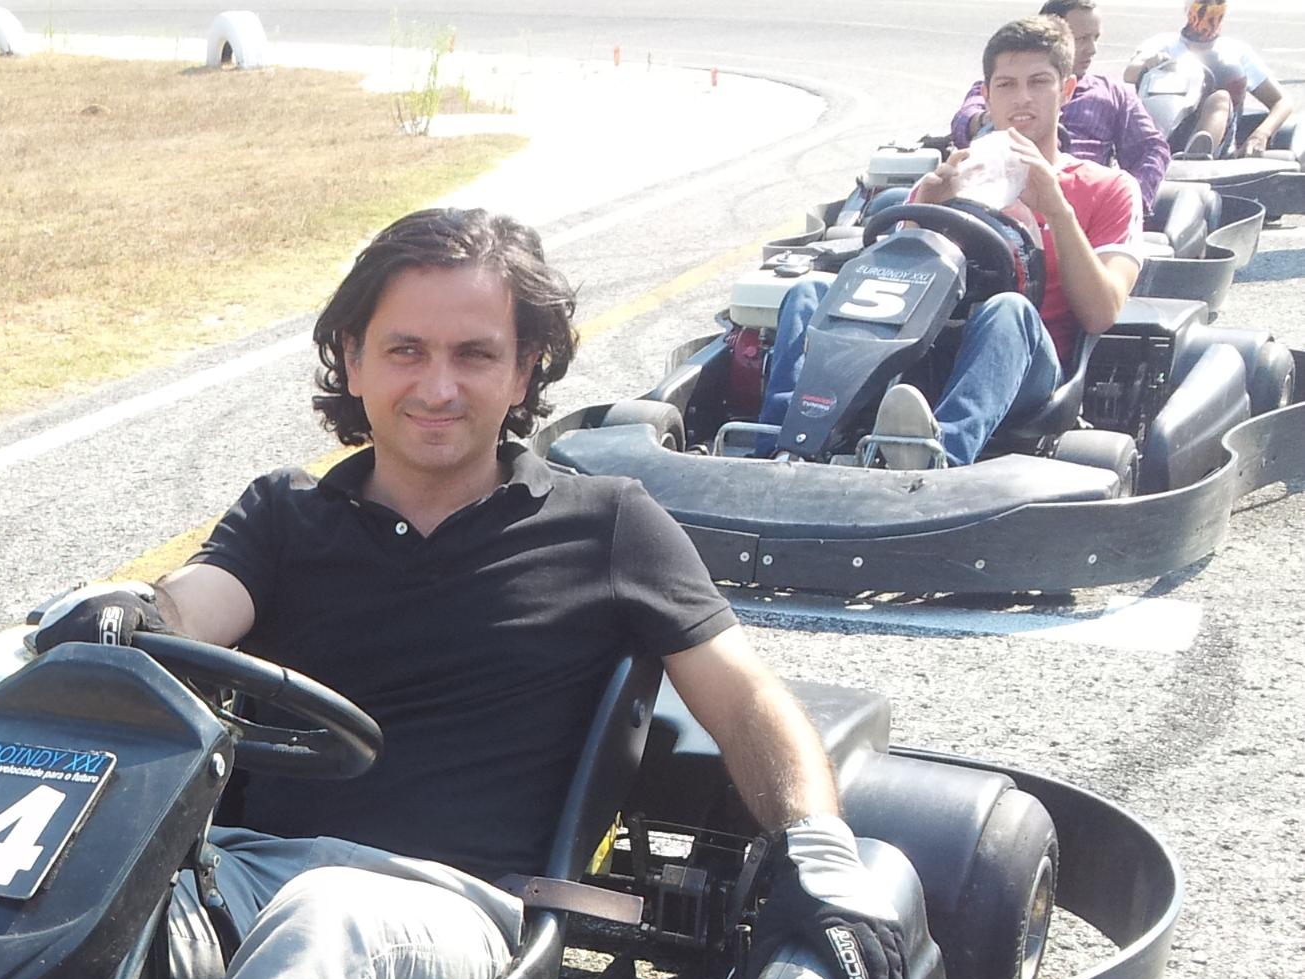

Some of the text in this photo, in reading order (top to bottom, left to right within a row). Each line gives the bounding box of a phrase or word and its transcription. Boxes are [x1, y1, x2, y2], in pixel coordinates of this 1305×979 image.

[840, 280, 910, 317] 5
[62, 752, 109, 773] XXI
[41, 769, 65, 780] para
[71, 772, 100, 783] futuro
